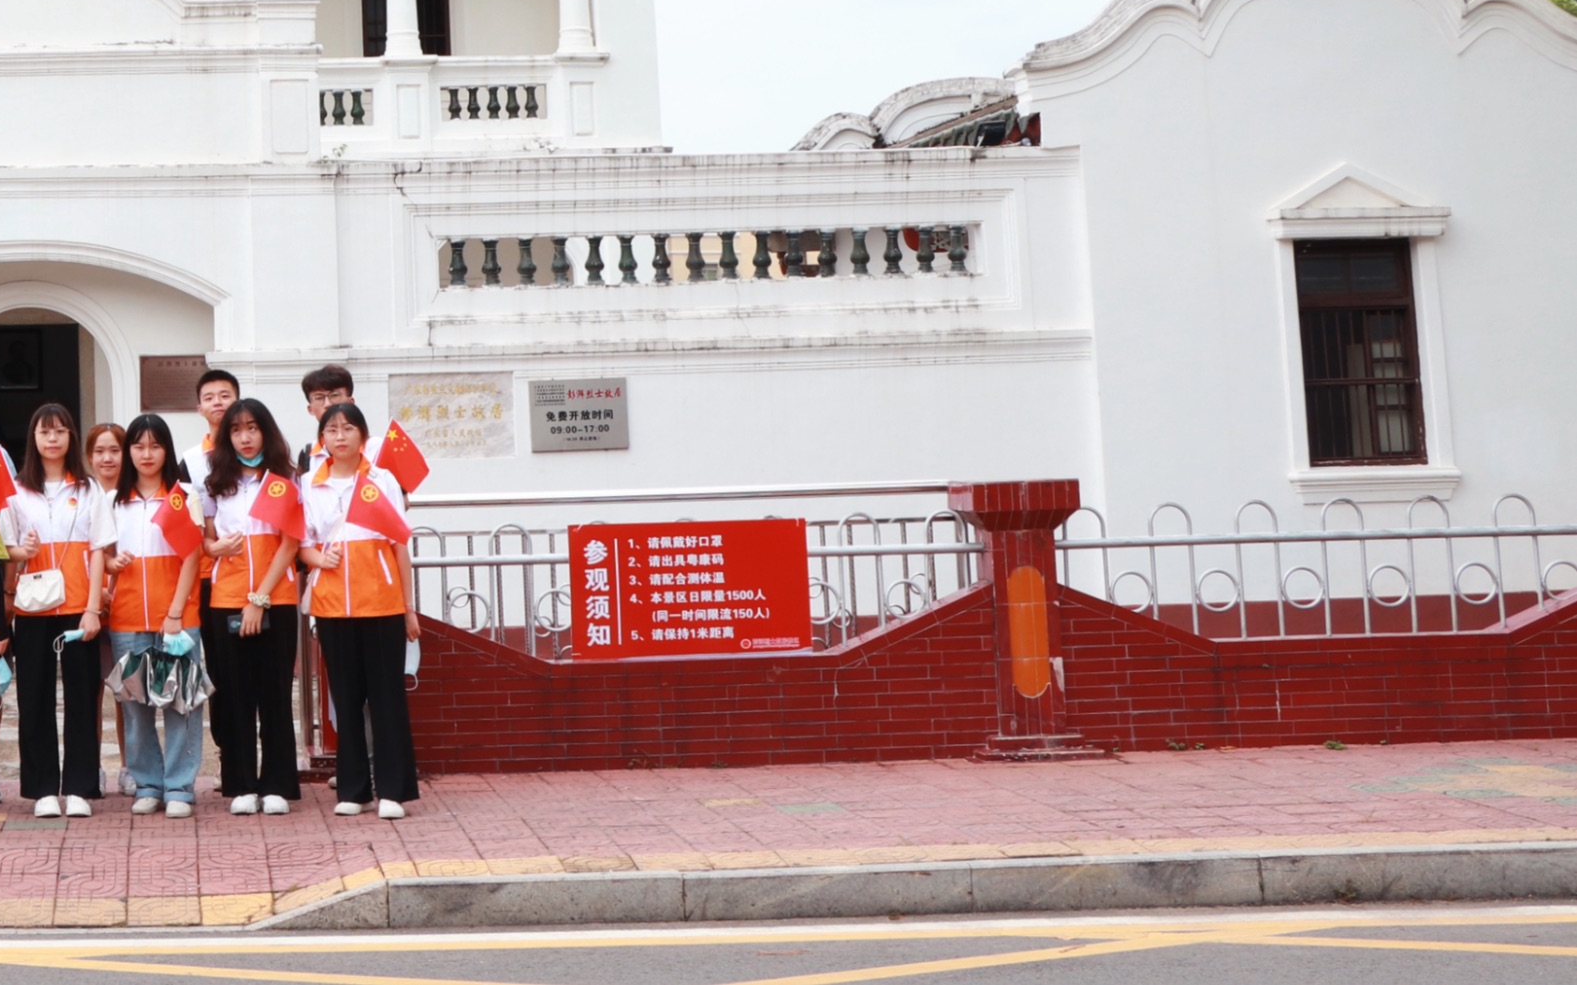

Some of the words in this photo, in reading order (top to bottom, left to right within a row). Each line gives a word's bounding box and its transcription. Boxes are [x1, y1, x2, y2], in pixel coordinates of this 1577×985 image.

[567, 387, 622, 400] 彭湃烈士故居
[546, 409, 613, 422] 免费开放时间
[583, 539, 611, 647] 参观须知
